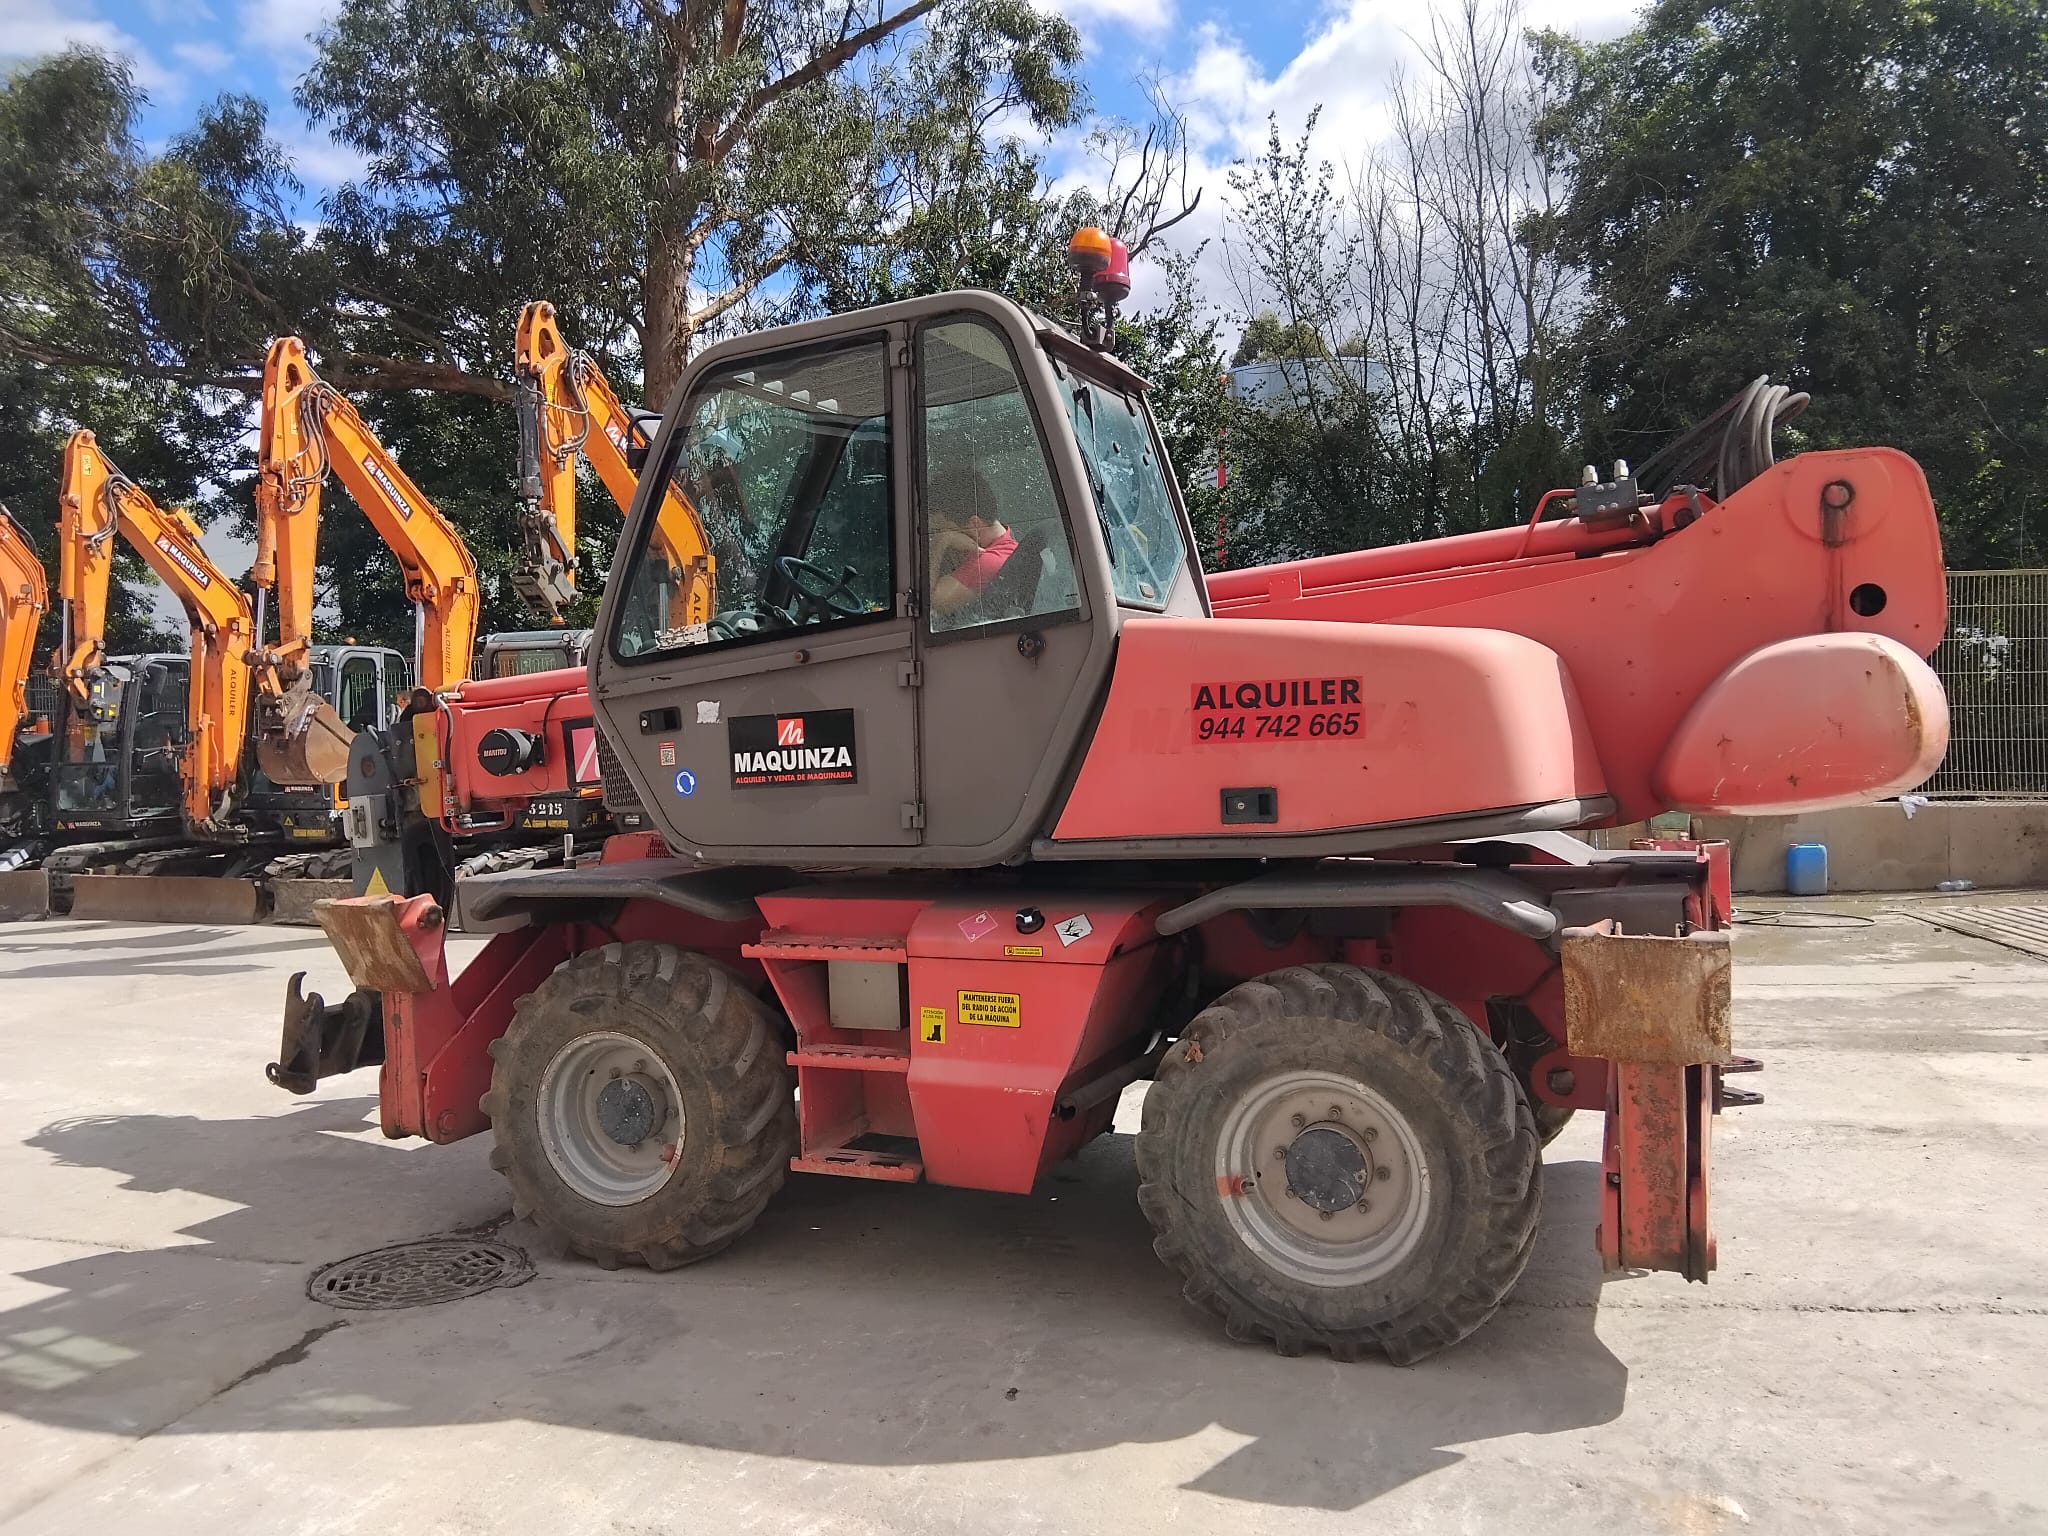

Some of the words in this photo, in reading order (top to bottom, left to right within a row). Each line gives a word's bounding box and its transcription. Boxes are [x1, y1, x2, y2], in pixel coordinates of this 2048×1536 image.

[375, 468, 411, 517] MAQUINZA
[169, 544, 209, 585] MAQUINZA
[229, 668, 237, 716] ALQUILER
[1193, 679, 1362, 710] ALQUILER
[1198, 716, 1245, 740] 944
[1255, 714, 1301, 738] 742
[1309, 712, 1361, 737] 665
[483, 748, 508, 758] MANITOU
[734, 746, 853, 773] MAQUINZA
[735, 776, 766, 784] ALQUILER
[774, 774, 796, 782] VENTA
[797, 773, 806, 781] DE
[807, 771, 853, 780] MAQUINARIA
[961, 1003, 971, 1011] DEL
[972, 1004, 989, 1012] RADIO
[963, 993, 997, 1003] MANTENERSE
[998, 996, 1015, 1004] FUERA
[969, 1013, 976, 1021] DE
[977, 1013, 984, 1021] LA
